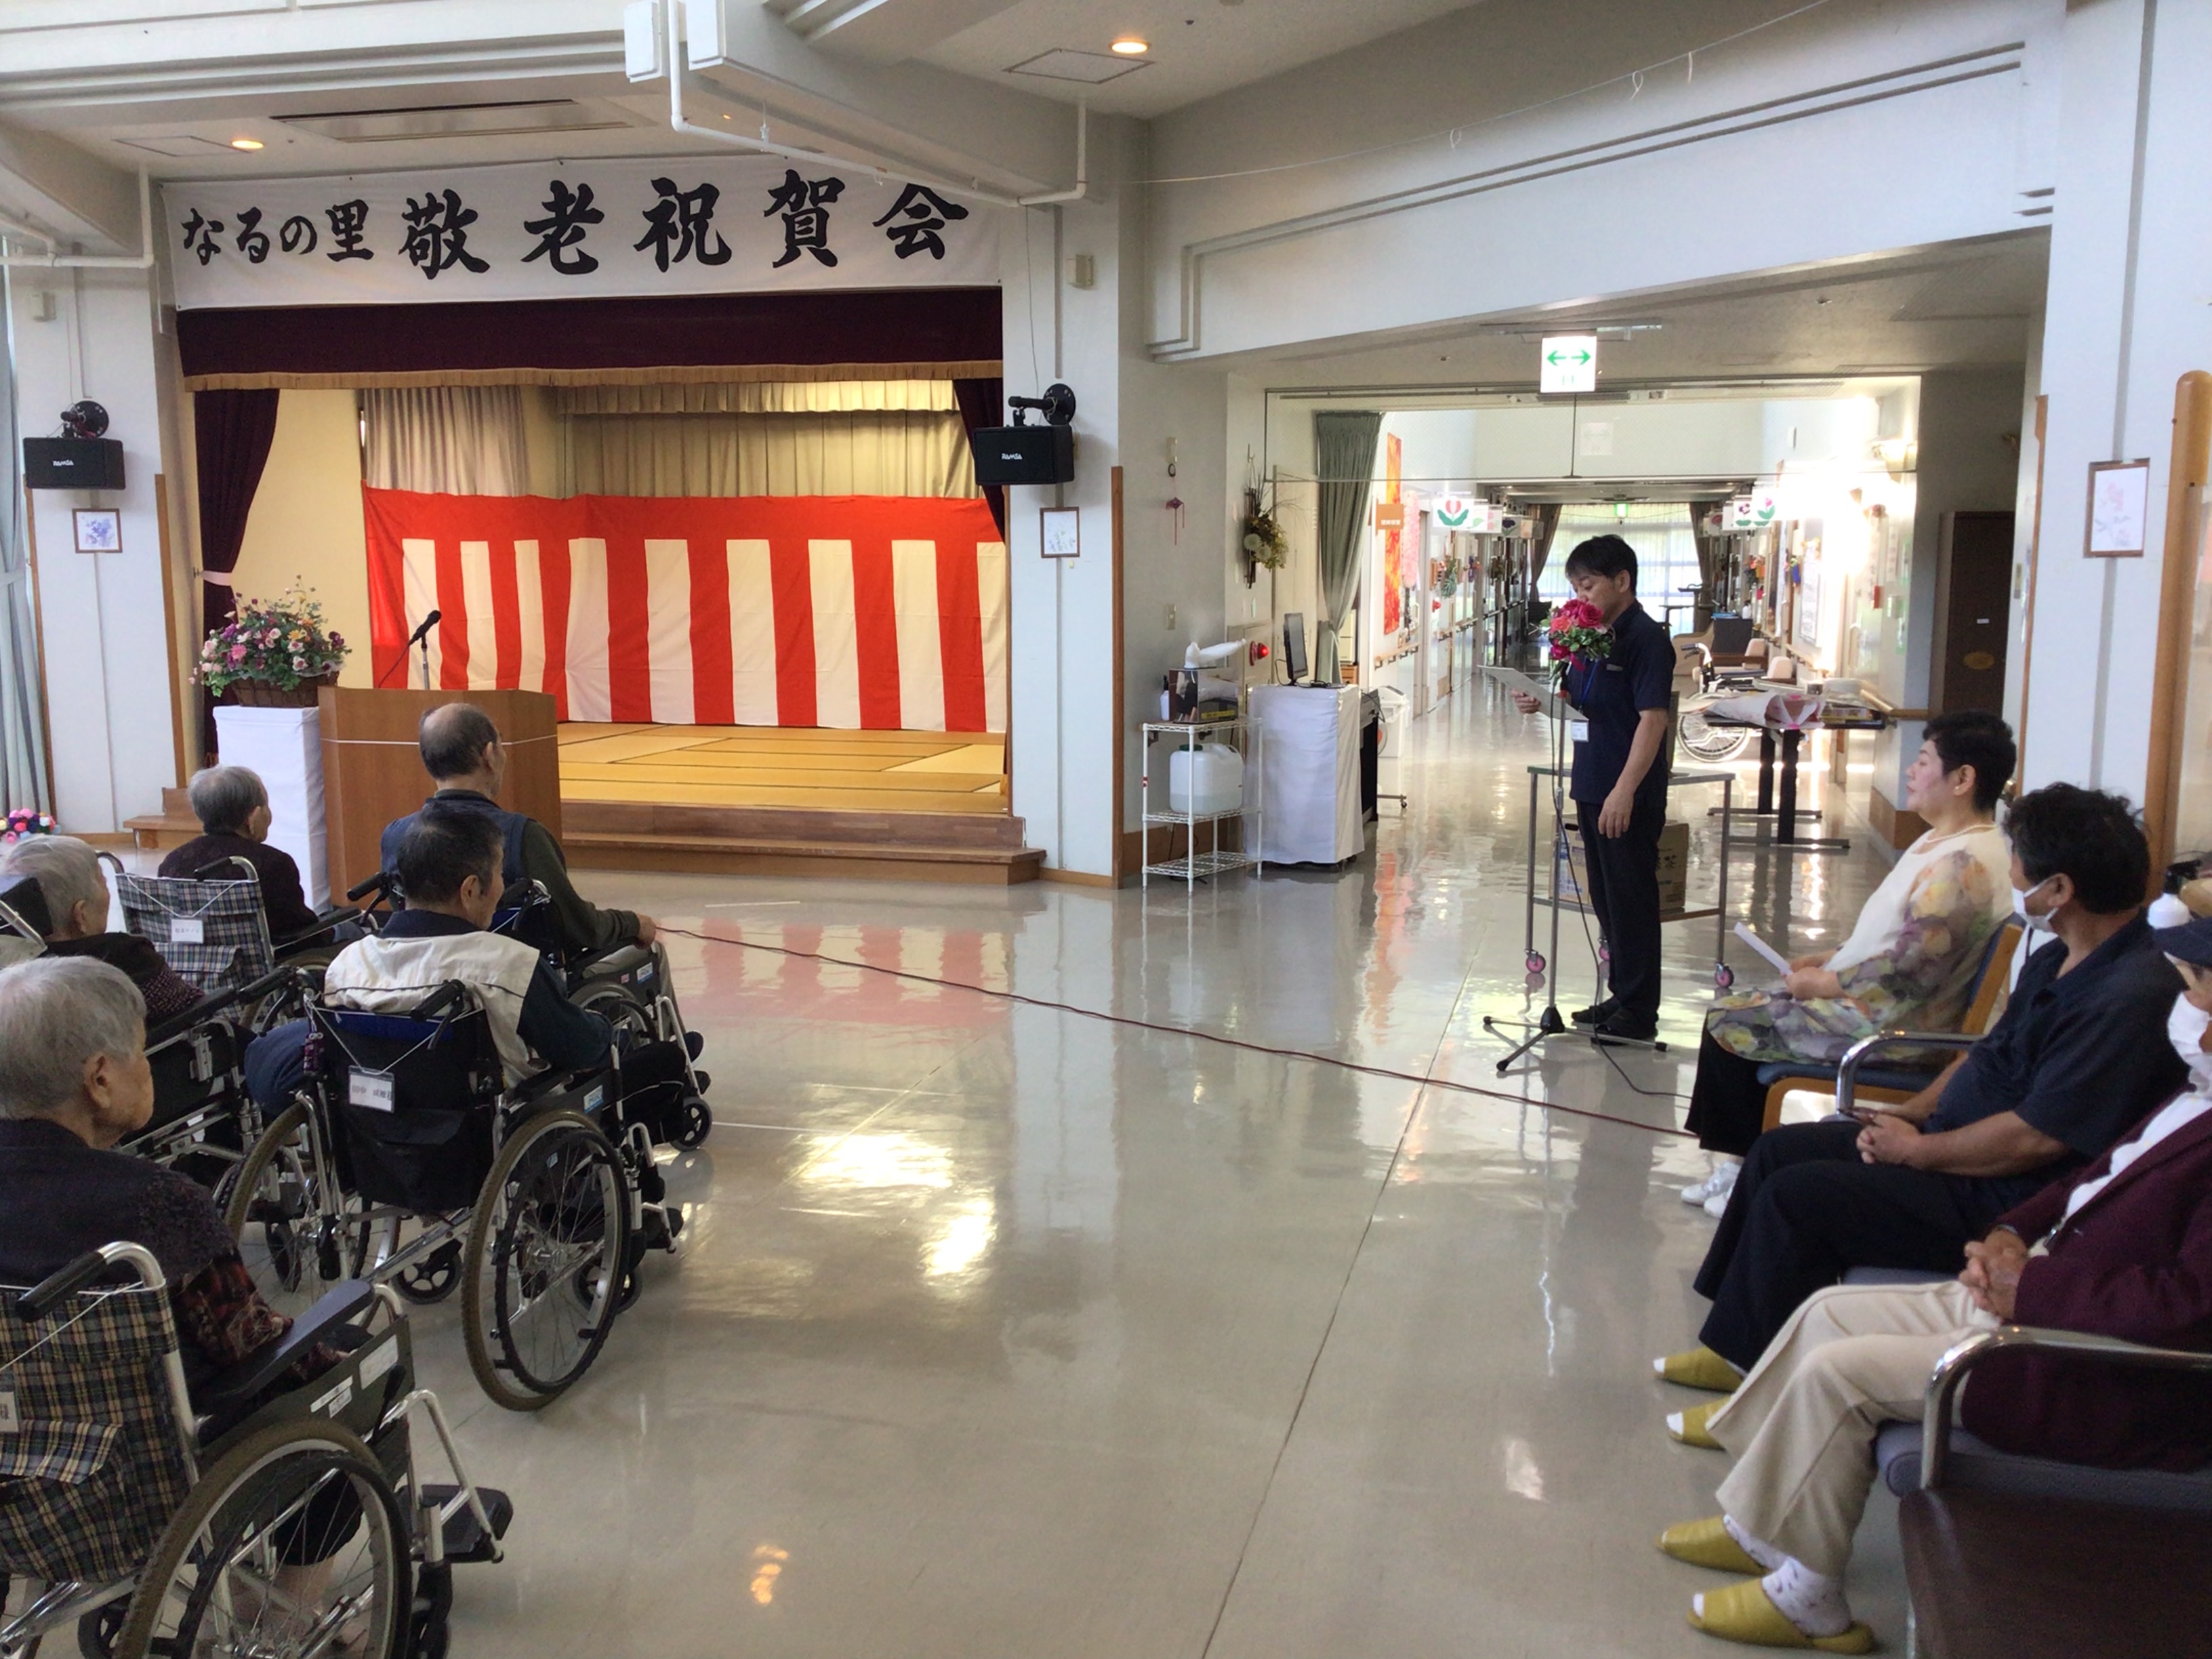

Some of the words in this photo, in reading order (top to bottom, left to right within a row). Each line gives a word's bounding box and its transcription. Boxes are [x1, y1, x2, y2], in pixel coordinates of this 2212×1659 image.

[181, 199, 374, 266] なるの里
[398, 168, 970, 281] 敬老祝賀会
